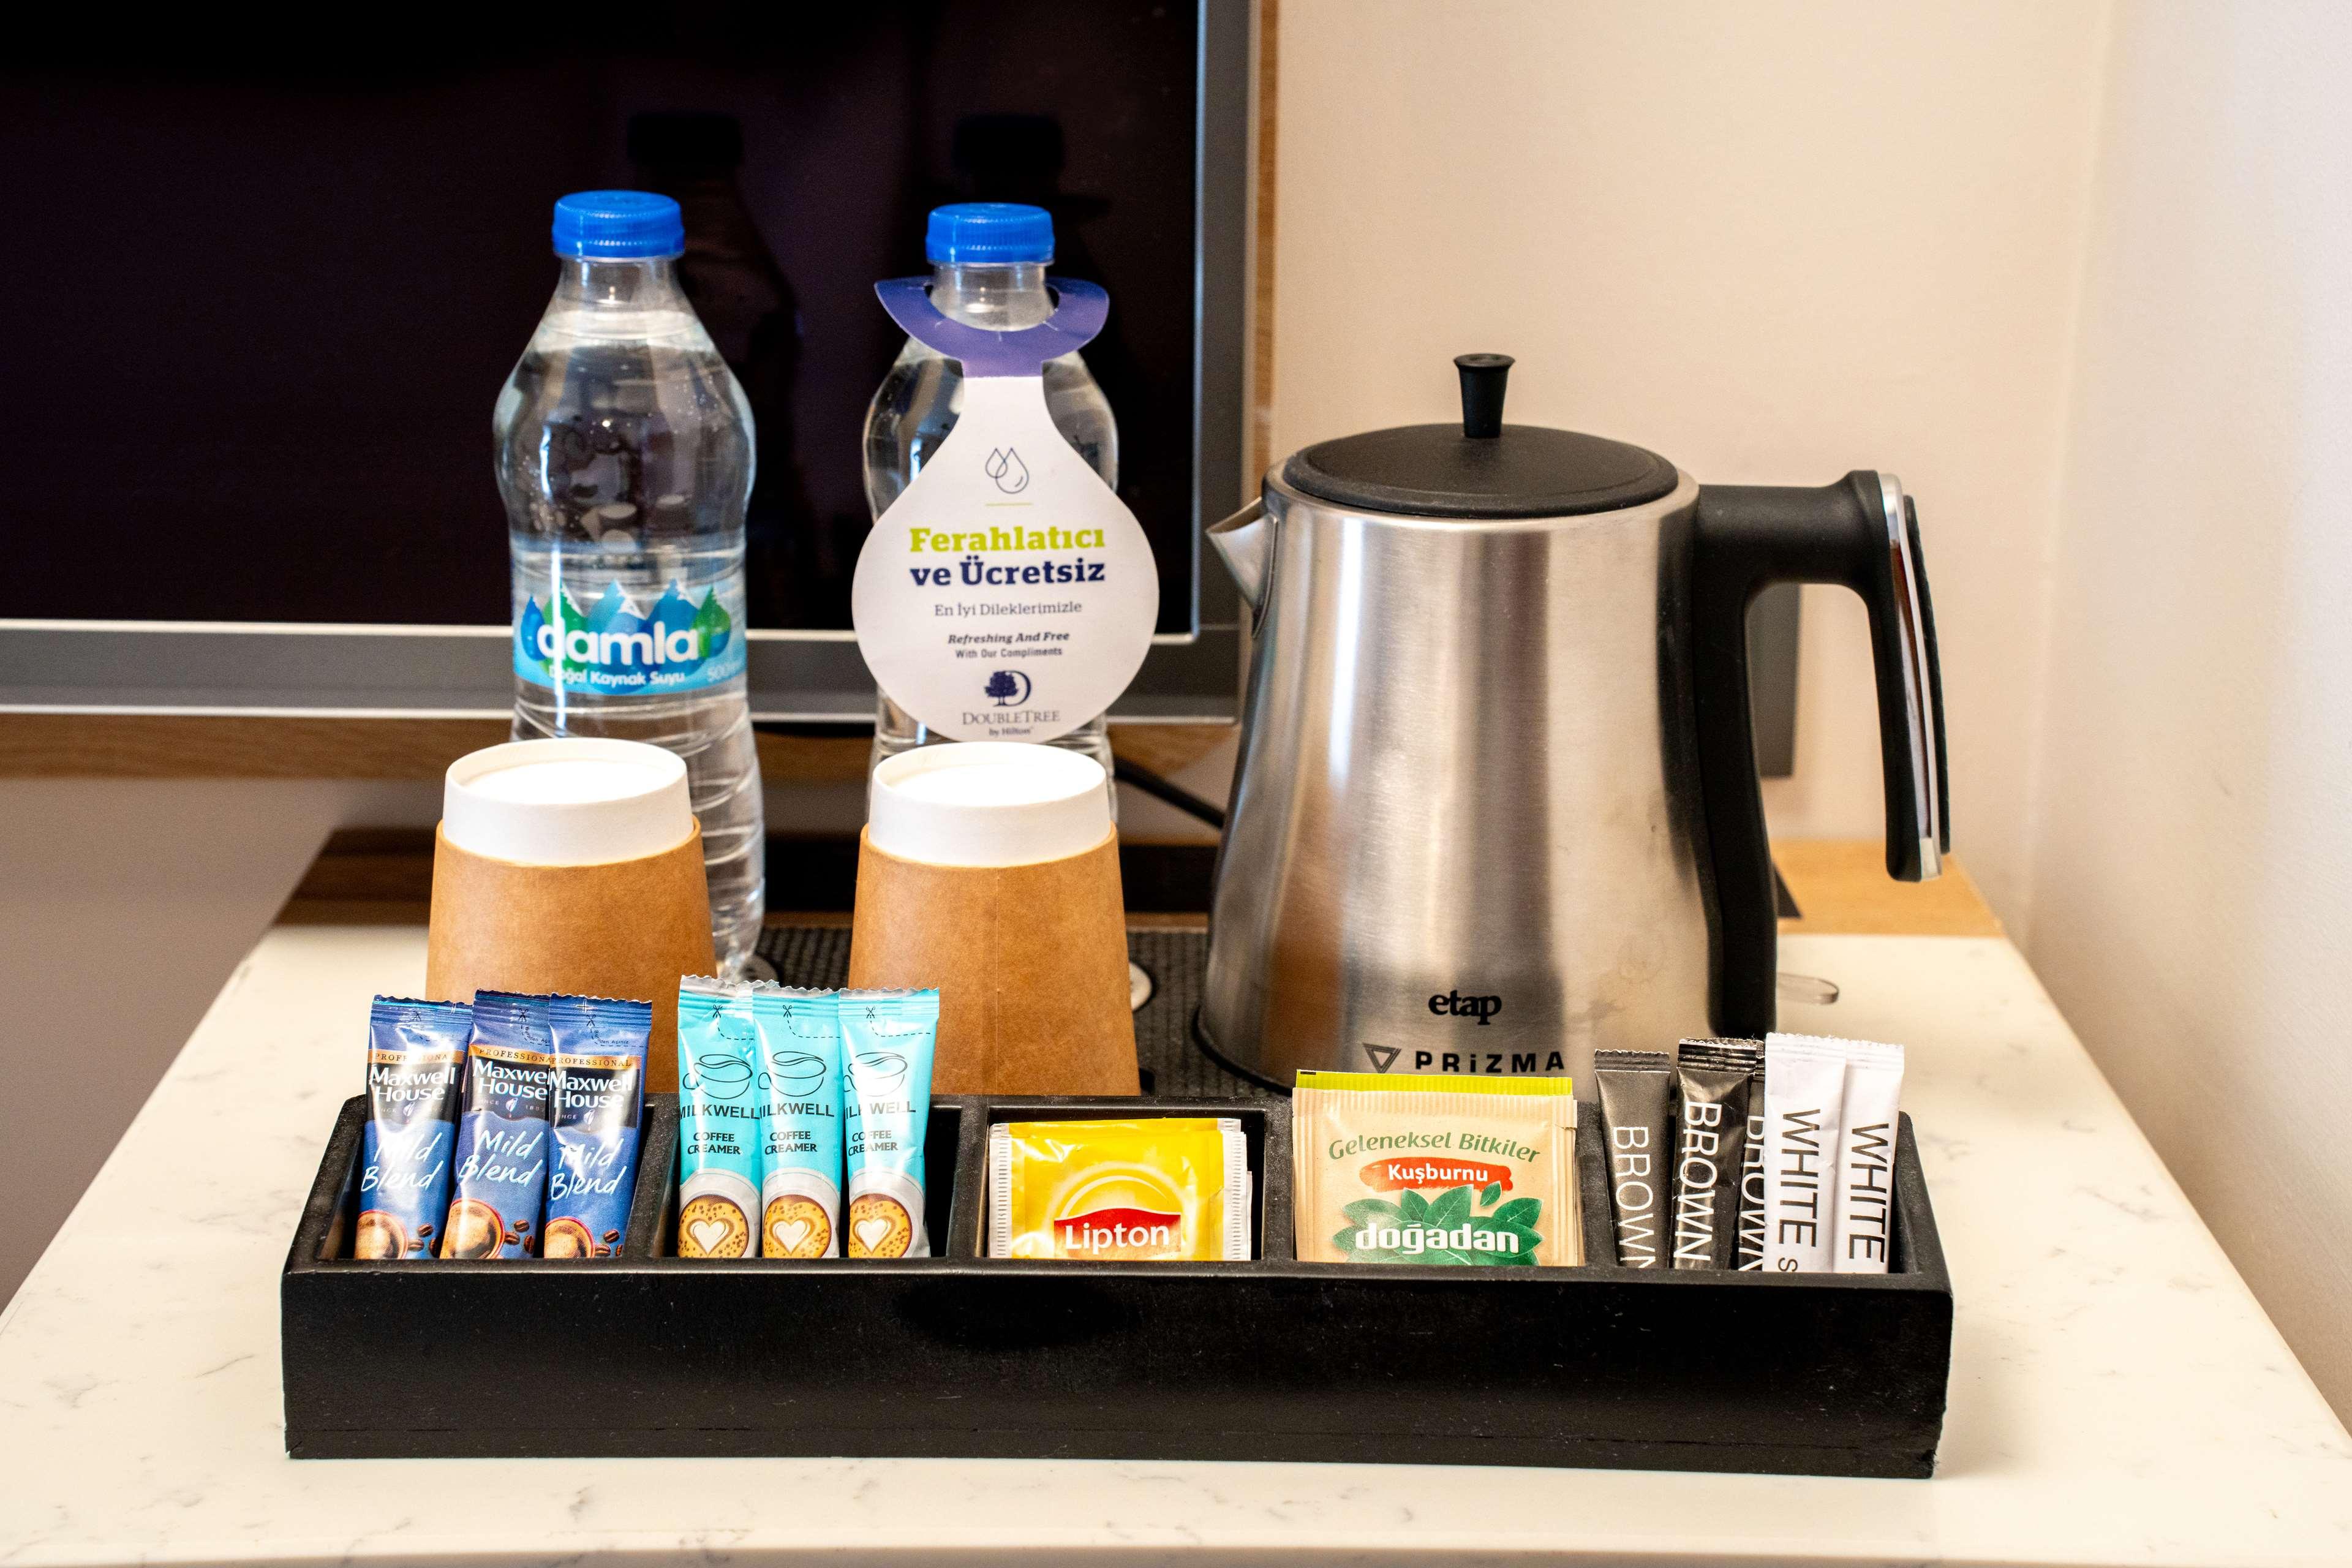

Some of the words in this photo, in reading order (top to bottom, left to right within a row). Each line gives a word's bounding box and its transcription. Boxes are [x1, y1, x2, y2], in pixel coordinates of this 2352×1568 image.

[910, 526, 1106, 552] Ferahlatıcı
[910, 566, 951, 586] ve
[959, 555, 1106, 586] Ücretsiz
[934, 605, 954, 617] En
[957, 602, 976, 617] İyi
[980, 601, 1083, 616] Dileklerimizle
[537, 616, 699, 666] damla
[948, 633, 1012, 645] Refreshing
[1015, 632, 1040, 643] And
[1043, 631, 1070, 641] Free
[955, 648, 978, 658] With
[981, 649, 997, 658] Our
[1000, 647, 1063, 659] Compliments
[590, 671, 646, 688] Kaynak
[649, 670, 685, 685] Suyu
[989, 727, 1000, 737] by
[1428, 989, 1502, 1025] etap
[479, 1049, 550, 1064] PROFESSIONA
[369, 1066, 456, 1087] Maxwell
[473, 1058, 550, 1085] Maxwel
[549, 1070, 633, 1092] Maxwell
[375, 1086, 445, 1102] House
[478, 1077, 548, 1101] House
[554, 1090, 624, 1109] House
[373, 1132, 442, 1163] Mild
[477, 1130, 544, 1160] Mild
[693, 1131, 736, 1142] COFFEE
[769, 1130, 812, 1142] COFFEE
[1329, 1131, 1452, 1160] Geleneksel
[1459, 1133, 1540, 1163] Bitkiler
[558, 1138, 624, 1169] Mild
[687, 1144, 741, 1155] CREAMER
[764, 1142, 818, 1156] CREAMER
[848, 1142, 899, 1156] CREAMER
[361, 1161, 444, 1193] Blend
[458, 1154, 543, 1188] Blend
[550, 1166, 627, 1201] Blend
[1387, 1163, 1488, 1183] Kuşburnu
[1673, 1102, 1722, 1262] BROWN
[1778, 1109, 1821, 1248] WHITE
[1849, 1123, 1890, 1264] WHITE
[1066, 1221, 1170, 1255] Lipton
[1355, 1222, 1519, 1256] doğadan
